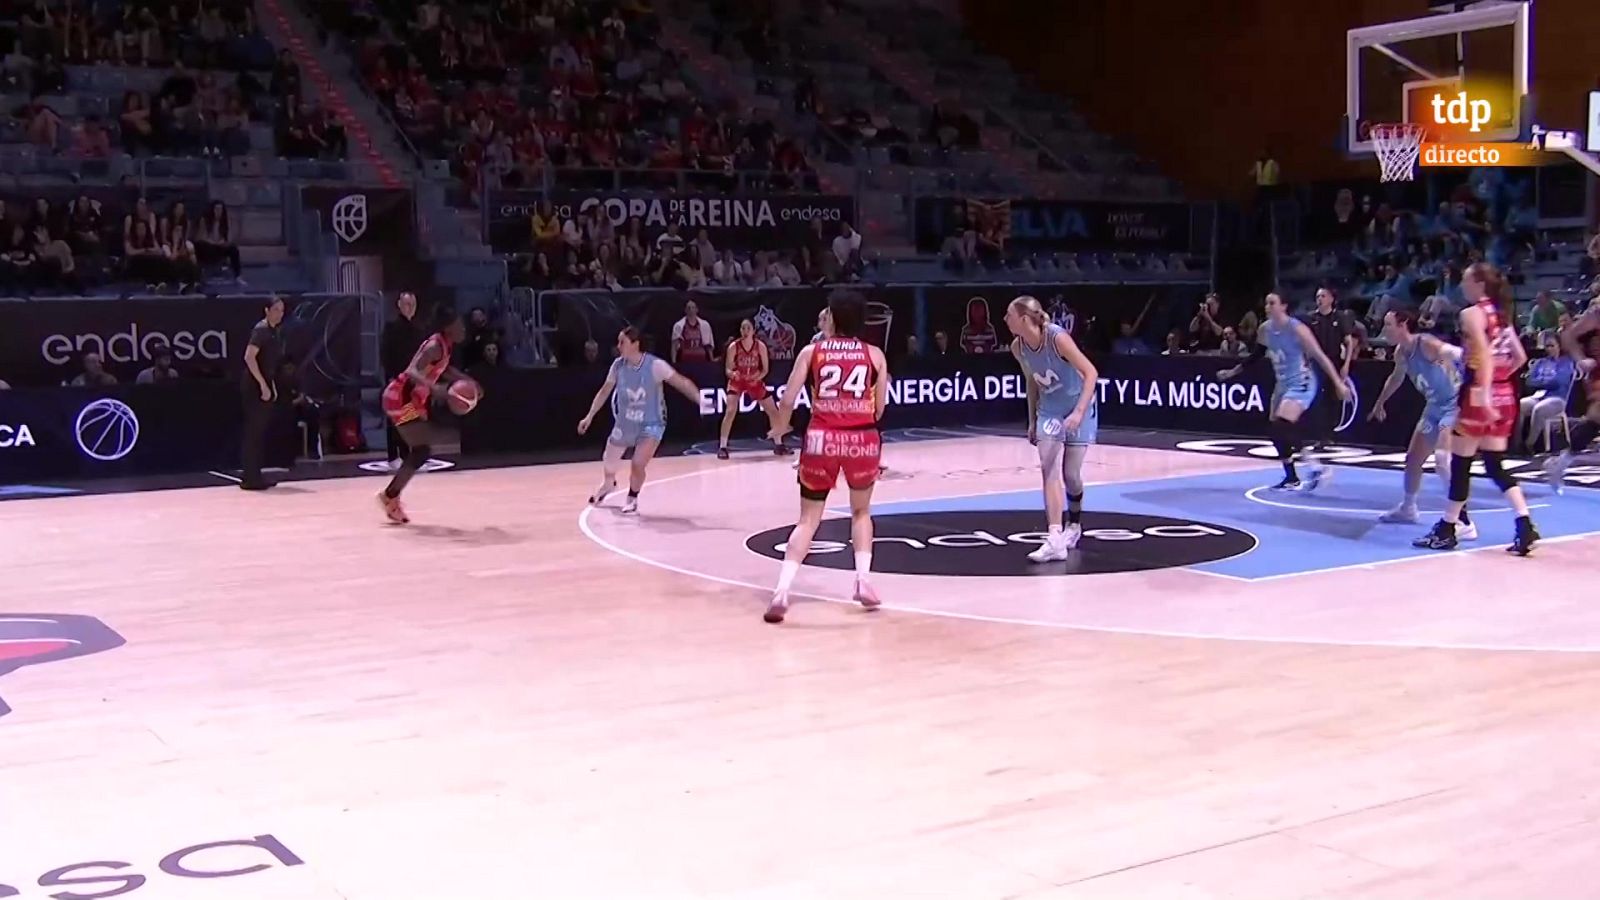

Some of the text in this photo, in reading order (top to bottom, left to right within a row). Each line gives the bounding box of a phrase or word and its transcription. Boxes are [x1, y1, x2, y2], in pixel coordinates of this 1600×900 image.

[501, 201, 571, 218] endsa
[689, 199, 776, 227] REINA
[780, 205, 841, 221] endesa
[42, 323, 228, 365] endesa
[818, 364, 868, 399] 24
[984, 374, 1028, 400] DEL
[1115, 379, 1130, 404] Y
[1134, 379, 1163, 407] LA
[1168, 375, 1264, 412] MÚSICA
